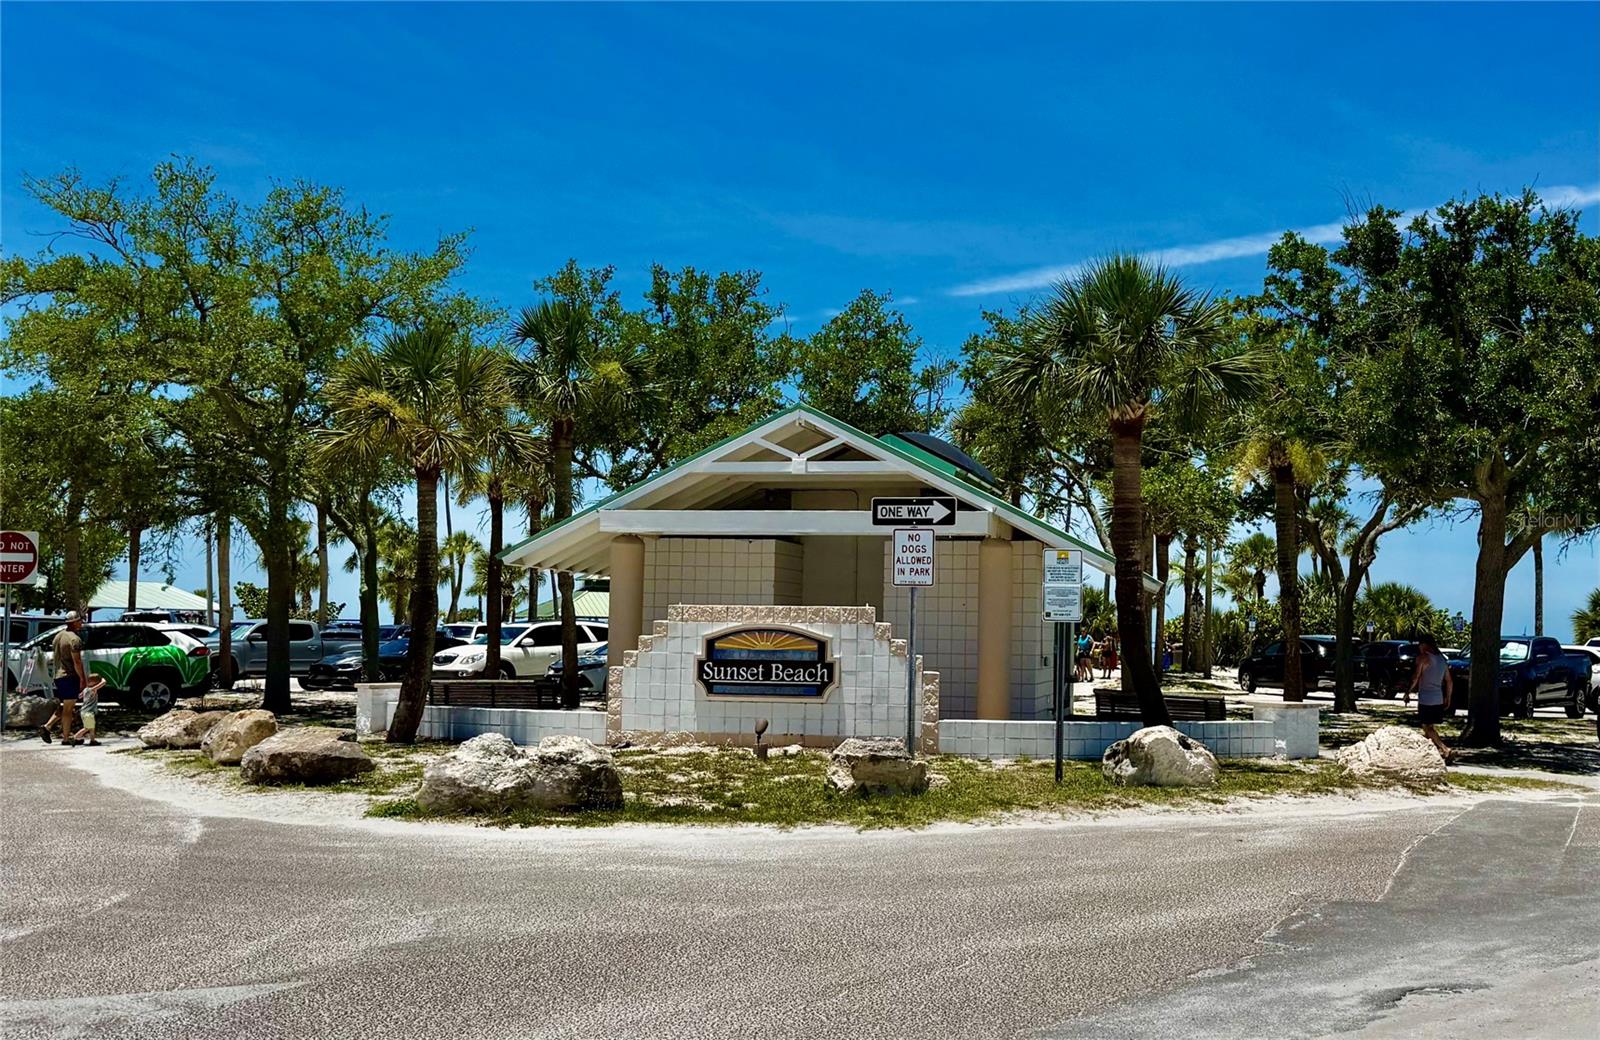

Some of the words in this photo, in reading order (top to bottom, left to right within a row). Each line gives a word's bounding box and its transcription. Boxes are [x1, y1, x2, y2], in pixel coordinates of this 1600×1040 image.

[880, 506, 903, 517] ONE
[907, 506, 930, 517] WAY
[908, 533, 921, 542] NO
[0, 541, 5, 550] O
[10, 541, 30, 550] NOT
[901, 545, 927, 553] DOGS
[896, 556, 931, 565] ALLOWED
[0, 564, 25, 573] NTER
[897, 567, 905, 576] IN
[909, 568, 930, 576] PARK
[703, 661, 764, 681] Sunset
[770, 662, 829, 682] Beach
